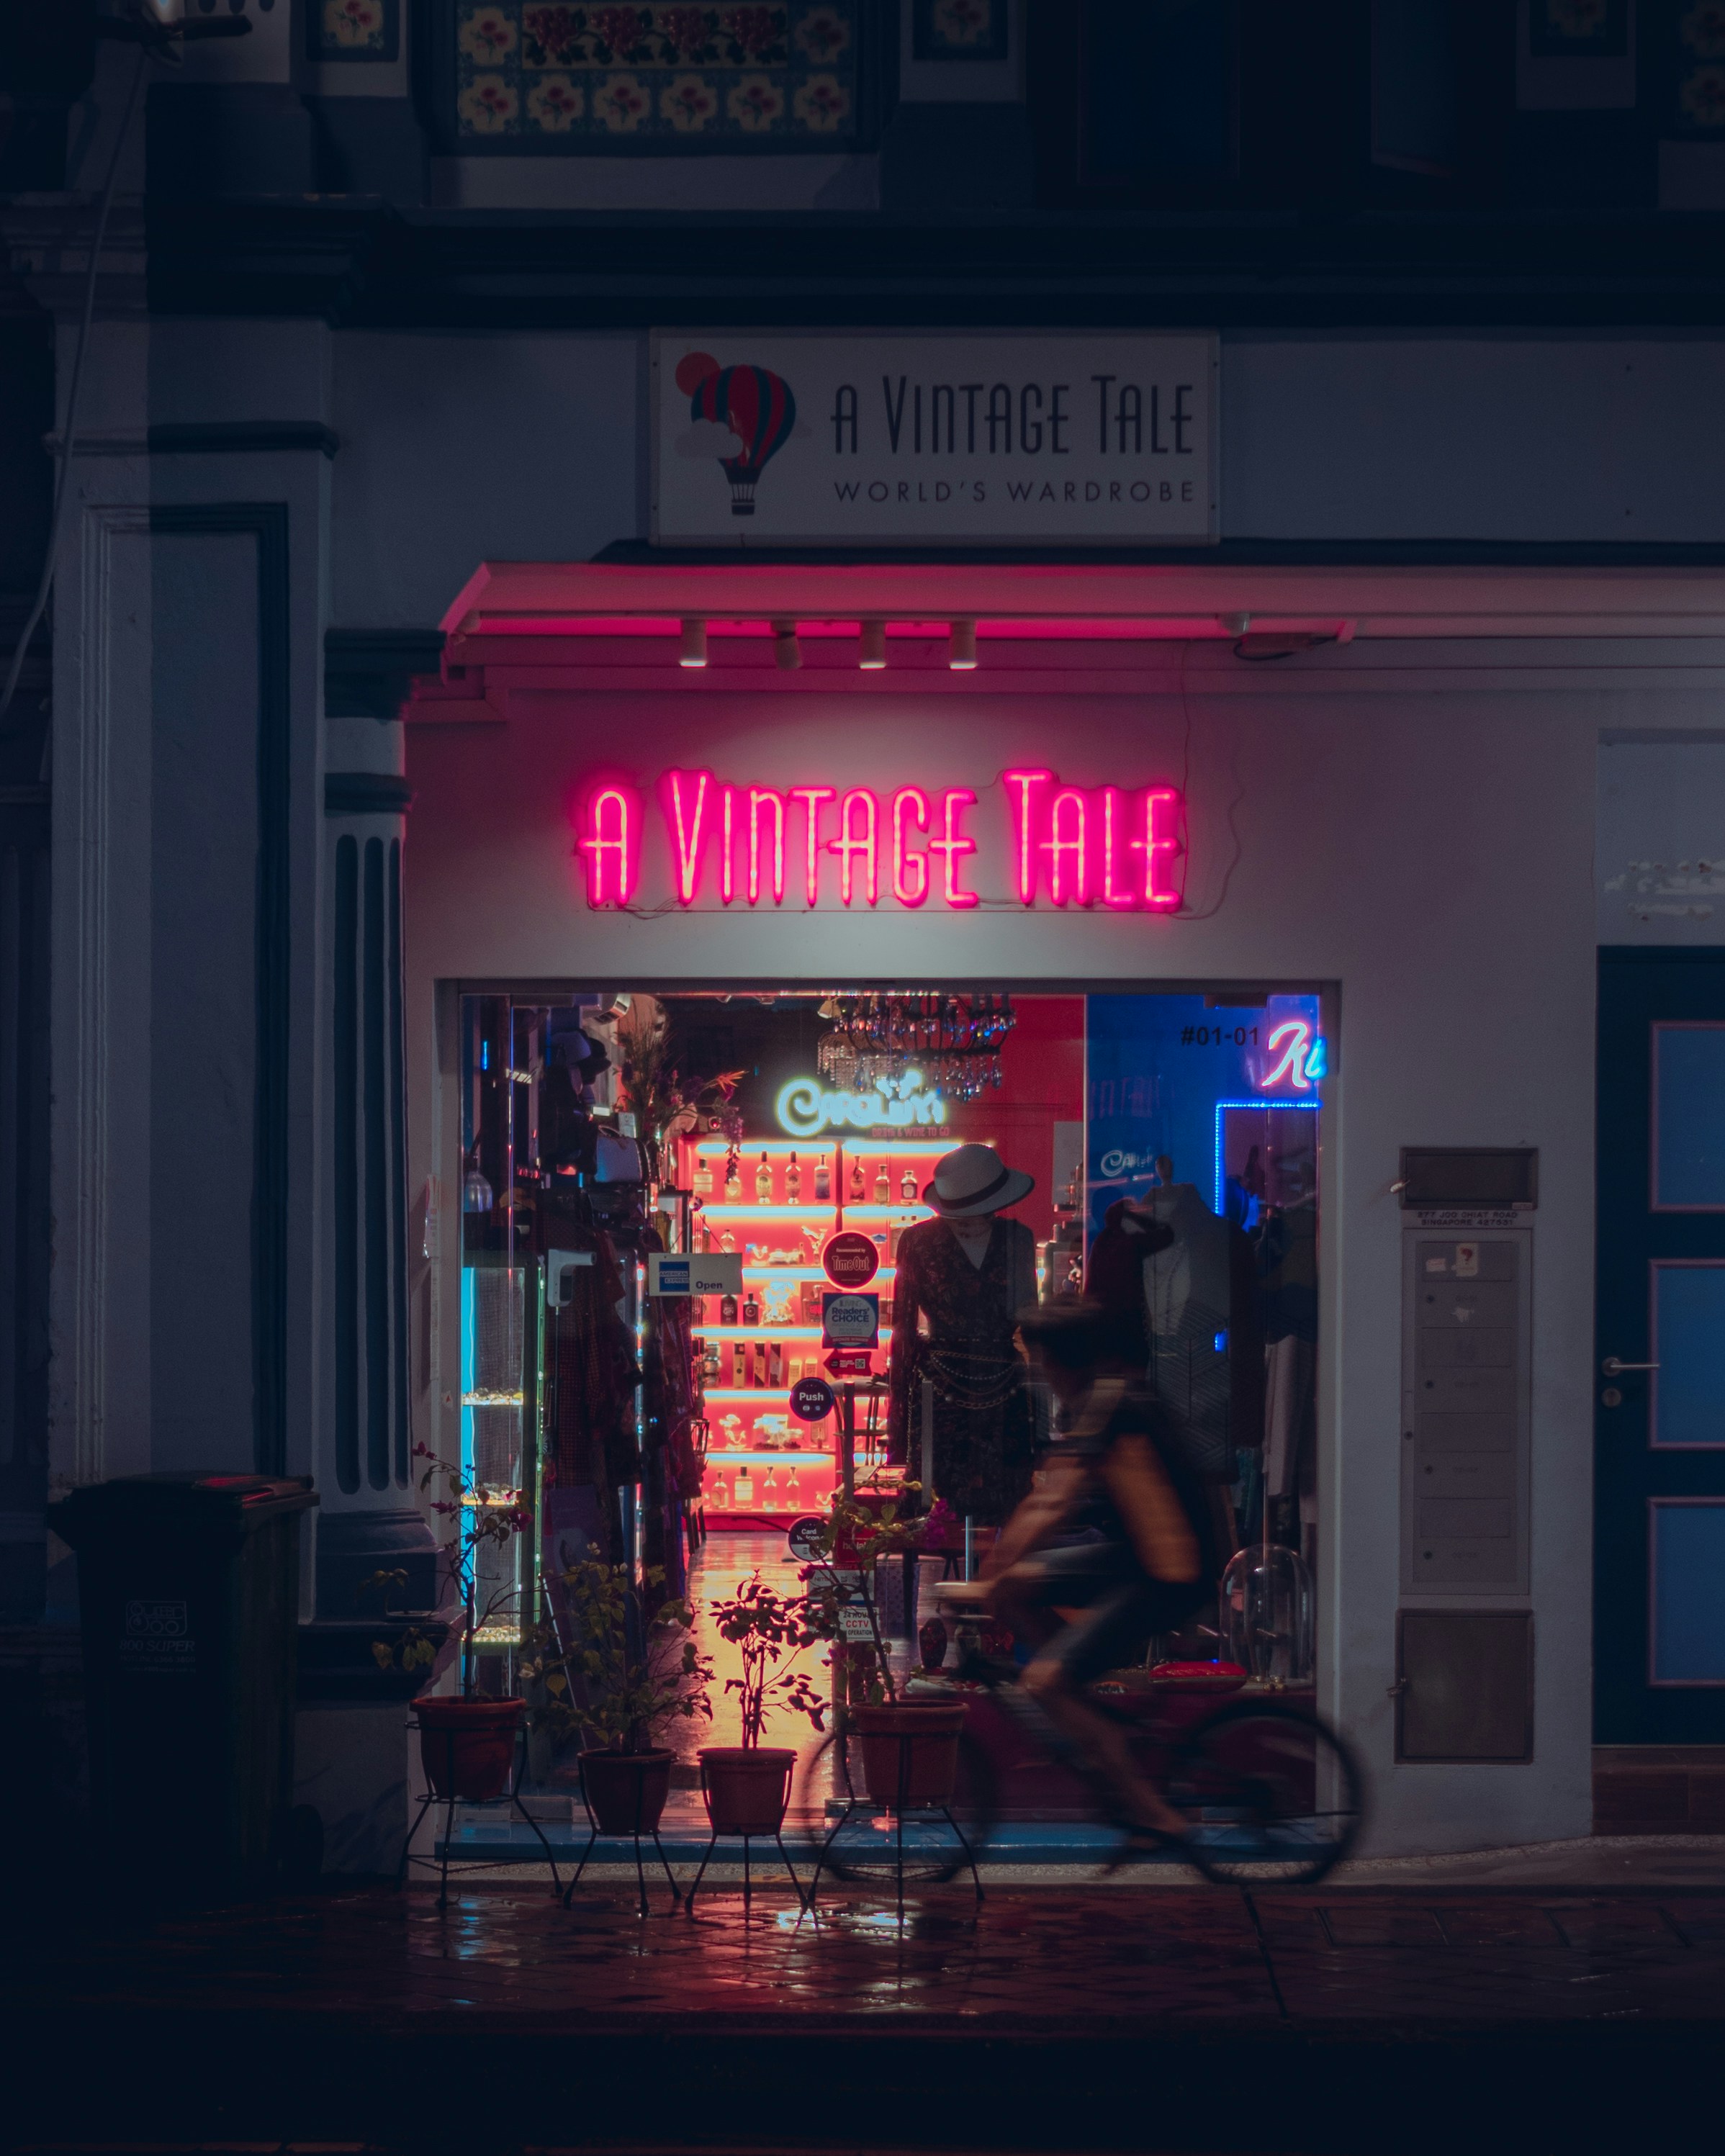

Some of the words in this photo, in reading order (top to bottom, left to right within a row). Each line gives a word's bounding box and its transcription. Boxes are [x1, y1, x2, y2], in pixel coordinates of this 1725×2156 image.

[830, 384, 857, 455] A
[882, 374, 1070, 455] VINTAGE
[1090, 374, 1194, 455] TALE
[834, 480, 986, 502] WORLD'S
[1007, 480, 1194, 502] WARDROBE
[578, 785, 631, 906] A
[667, 767, 979, 908] VINTAGE
[1004, 767, 1181, 911] TALE
[1181, 1026, 1258, 1046] #01-01
[695, 1281, 723, 1291] Open
[799, 1392, 824, 1401] Push
[120, 1640, 143, 1651] 800
[146, 1640, 196, 1652] SUPER
